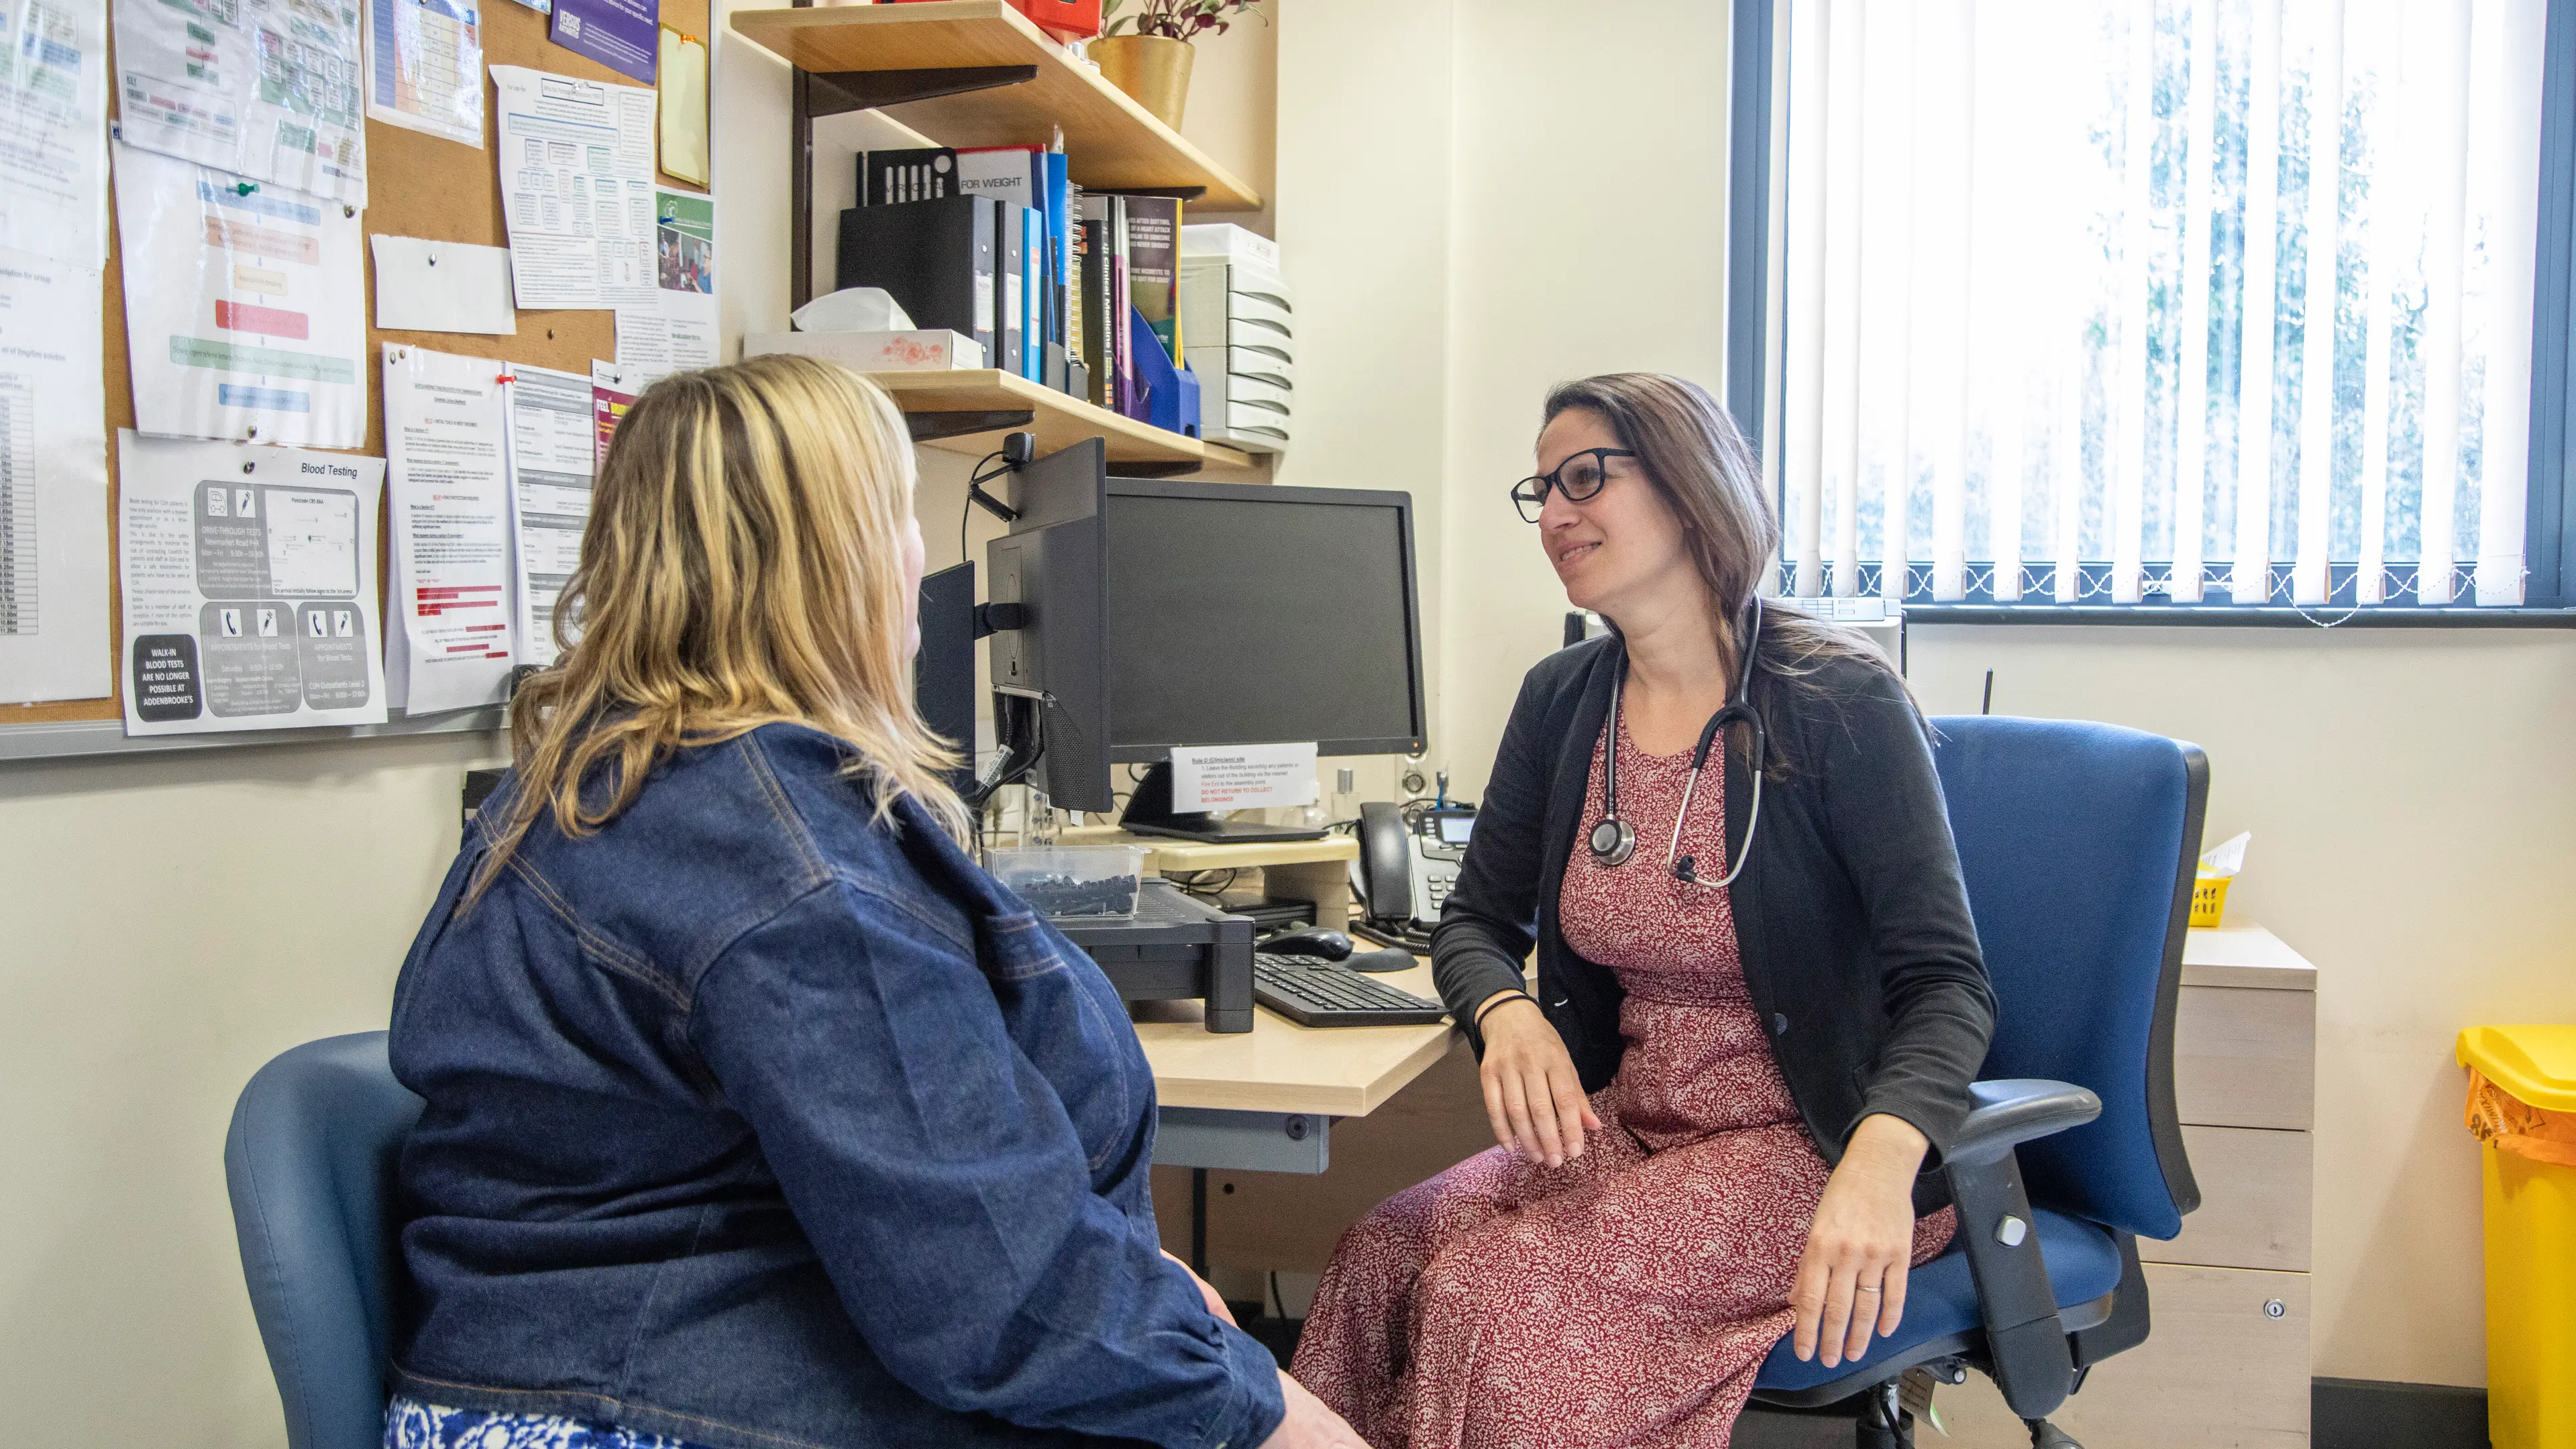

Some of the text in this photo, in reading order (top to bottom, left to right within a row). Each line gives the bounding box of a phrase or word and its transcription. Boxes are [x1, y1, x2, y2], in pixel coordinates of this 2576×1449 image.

[560, 9, 581, 32] VERSUS
[126, 75, 137, 87] KEY
[961, 177, 1022, 189] FOR WEIGHT
[302, 463, 358, 479] Blood Testing
[202, 526, 246, 535] DRIVE-THROUGH
[205, 538, 234, 546] Newmarket
[211, 643, 254, 651] APPOINTMENTS
[151, 649, 176, 657] WALK-IN
[146, 660, 184, 669] BLOOD TESTS
[142, 672, 190, 682] ARE NO LONGER
[150, 685, 176, 694] POSSIBLE
[321, 681, 347, 690] Outpatients
[144, 696, 193, 706] ADDENBROOKE'S
